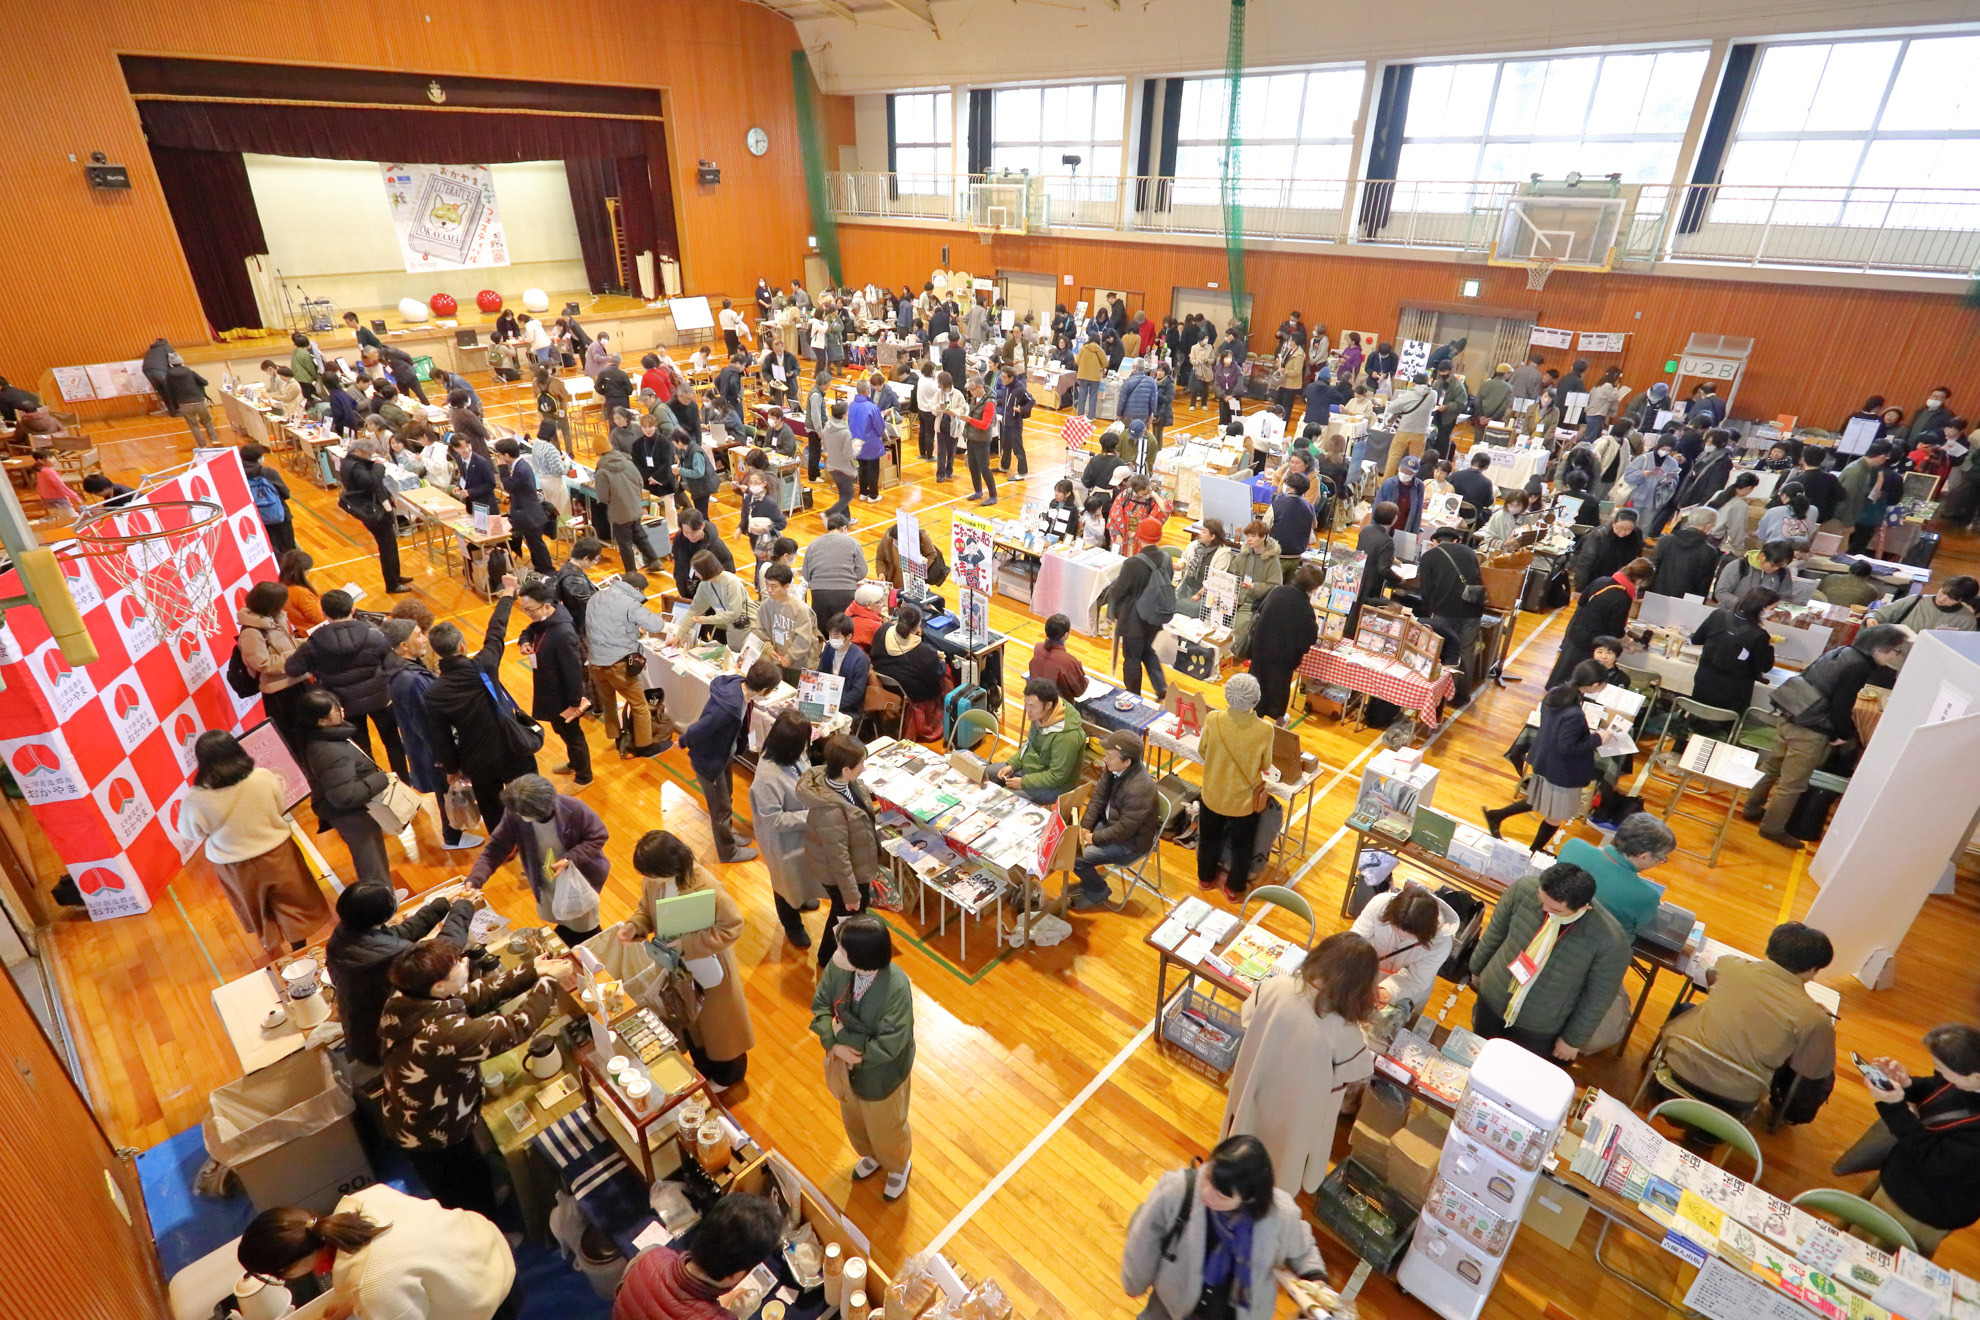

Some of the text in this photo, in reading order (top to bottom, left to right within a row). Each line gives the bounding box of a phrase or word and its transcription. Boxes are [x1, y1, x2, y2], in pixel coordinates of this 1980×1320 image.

[440, 166, 479, 187] おかやま
[433, 180, 476, 204] LITERATURE
[419, 225, 460, 245] OKAYAMA
[1684, 361, 1734, 378] U2B
[127, 716, 152, 744] おかやま
[249, 740, 268, 754] INE
[28, 784, 79, 799] おかやま
[124, 807, 149, 838] おかやま
[92, 902, 142, 916] おかやま
[1489, 1113, 1511, 1136] 豆本
[1458, 1203, 1478, 1224] 豆本
